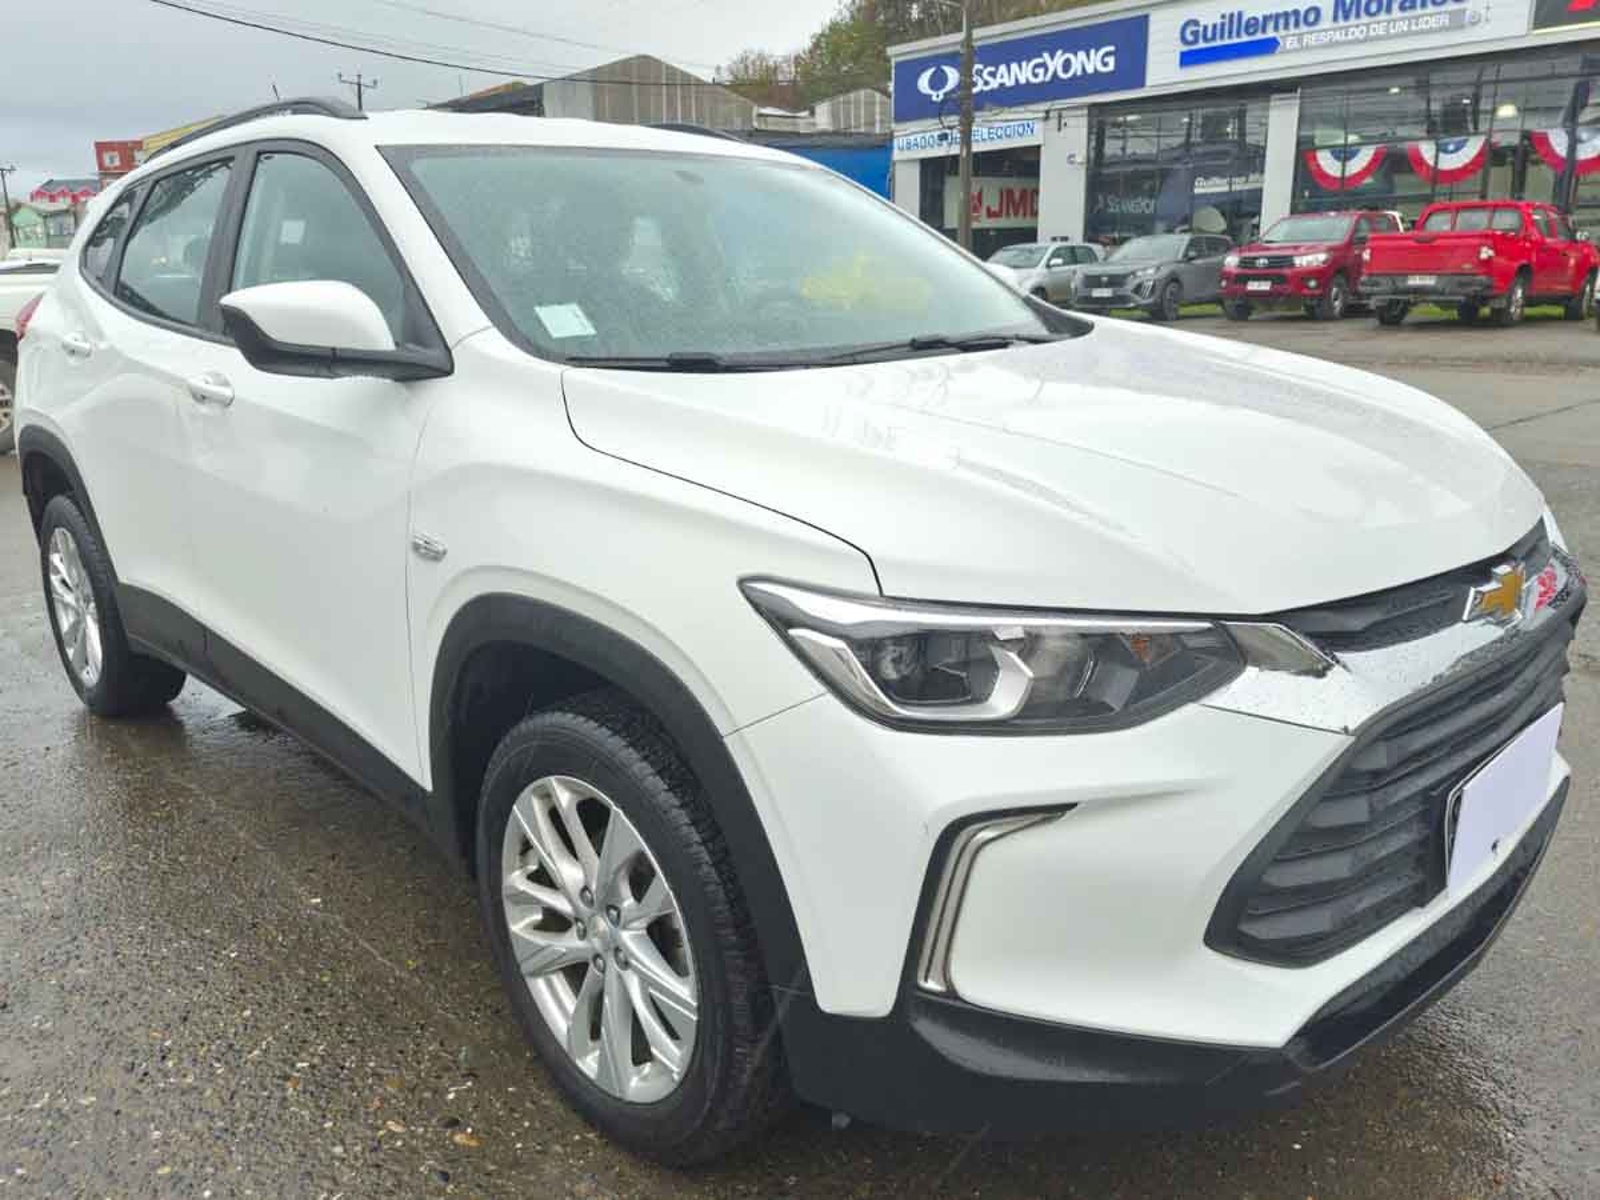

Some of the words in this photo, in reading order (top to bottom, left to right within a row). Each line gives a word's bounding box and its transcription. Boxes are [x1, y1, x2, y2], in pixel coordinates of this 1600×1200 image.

[1180, 6, 1322, 46] Guillermo
[1333, 0, 1469, 23] Mora
[1286, 36, 1300, 50] EL
[1302, 25, 1367, 48] RESPALDO
[1369, 22, 1388, 36] DE
[1389, 19, 1409, 33] UN
[972, 45, 1116, 94] SSANGYONG
[970, 121, 1036, 143] ELECCION
